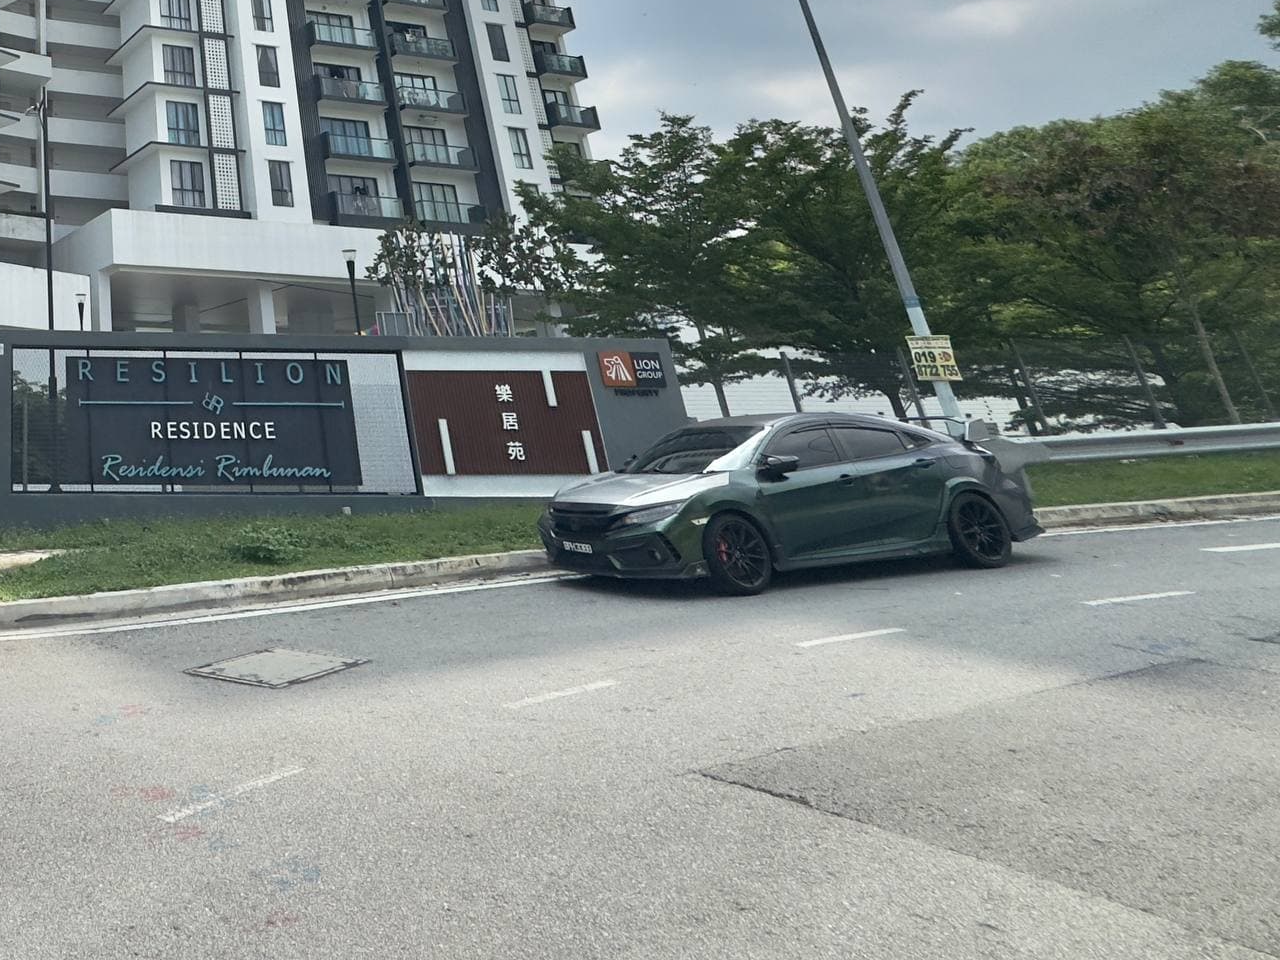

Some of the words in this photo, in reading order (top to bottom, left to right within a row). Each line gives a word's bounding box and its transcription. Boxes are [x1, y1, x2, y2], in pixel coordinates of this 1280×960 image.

[914, 351, 937, 364] 019
[633, 359, 660, 370] LION
[940, 364, 959, 377] 755
[78, 359, 343, 385] RESILION
[636, 370, 663, 379] GROUP
[150, 421, 277, 440] RESIDENCE
[100, 453, 206, 479] Residensi
[216, 453, 332, 482] Rimbunan
